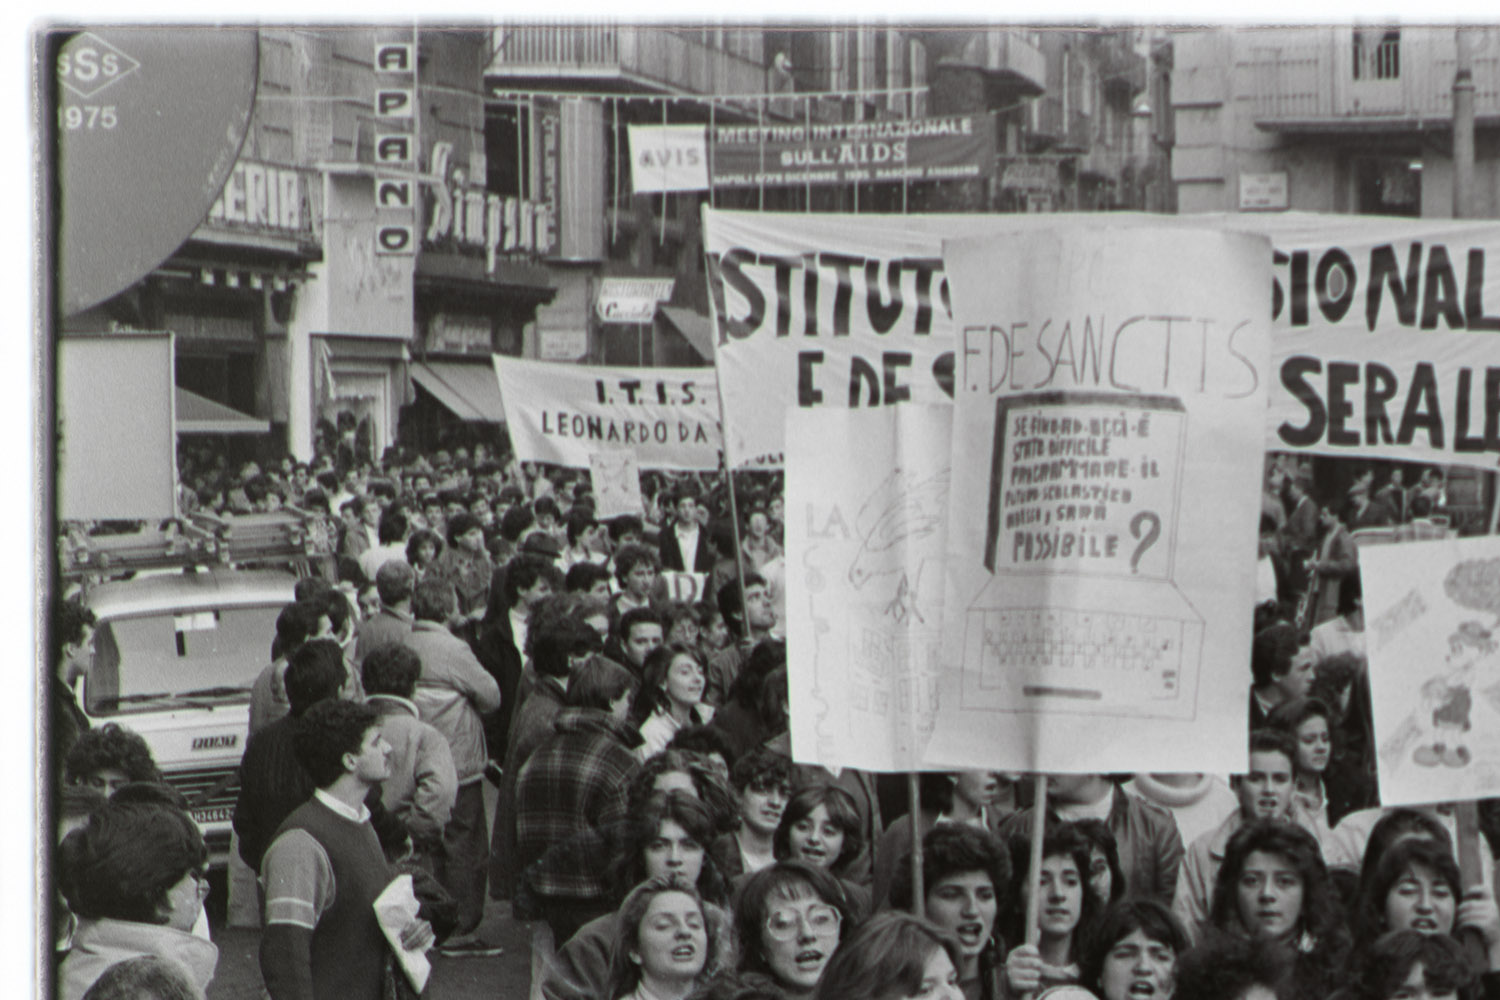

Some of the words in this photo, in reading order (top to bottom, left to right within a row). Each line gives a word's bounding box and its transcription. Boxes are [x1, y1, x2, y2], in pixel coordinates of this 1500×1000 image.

[717, 126, 803, 143] MEETING
[813, 118, 972, 141] INTERNAZIONALE
[639, 147, 701, 168] AVIS
[542, 410, 668, 445] LEONARDO
[678, 420, 708, 444] DA
[1049, 434, 1111, 457] DIFFICILE
[805, 503, 851, 540] LA
[1012, 525, 1119, 563] POSSIBILE
